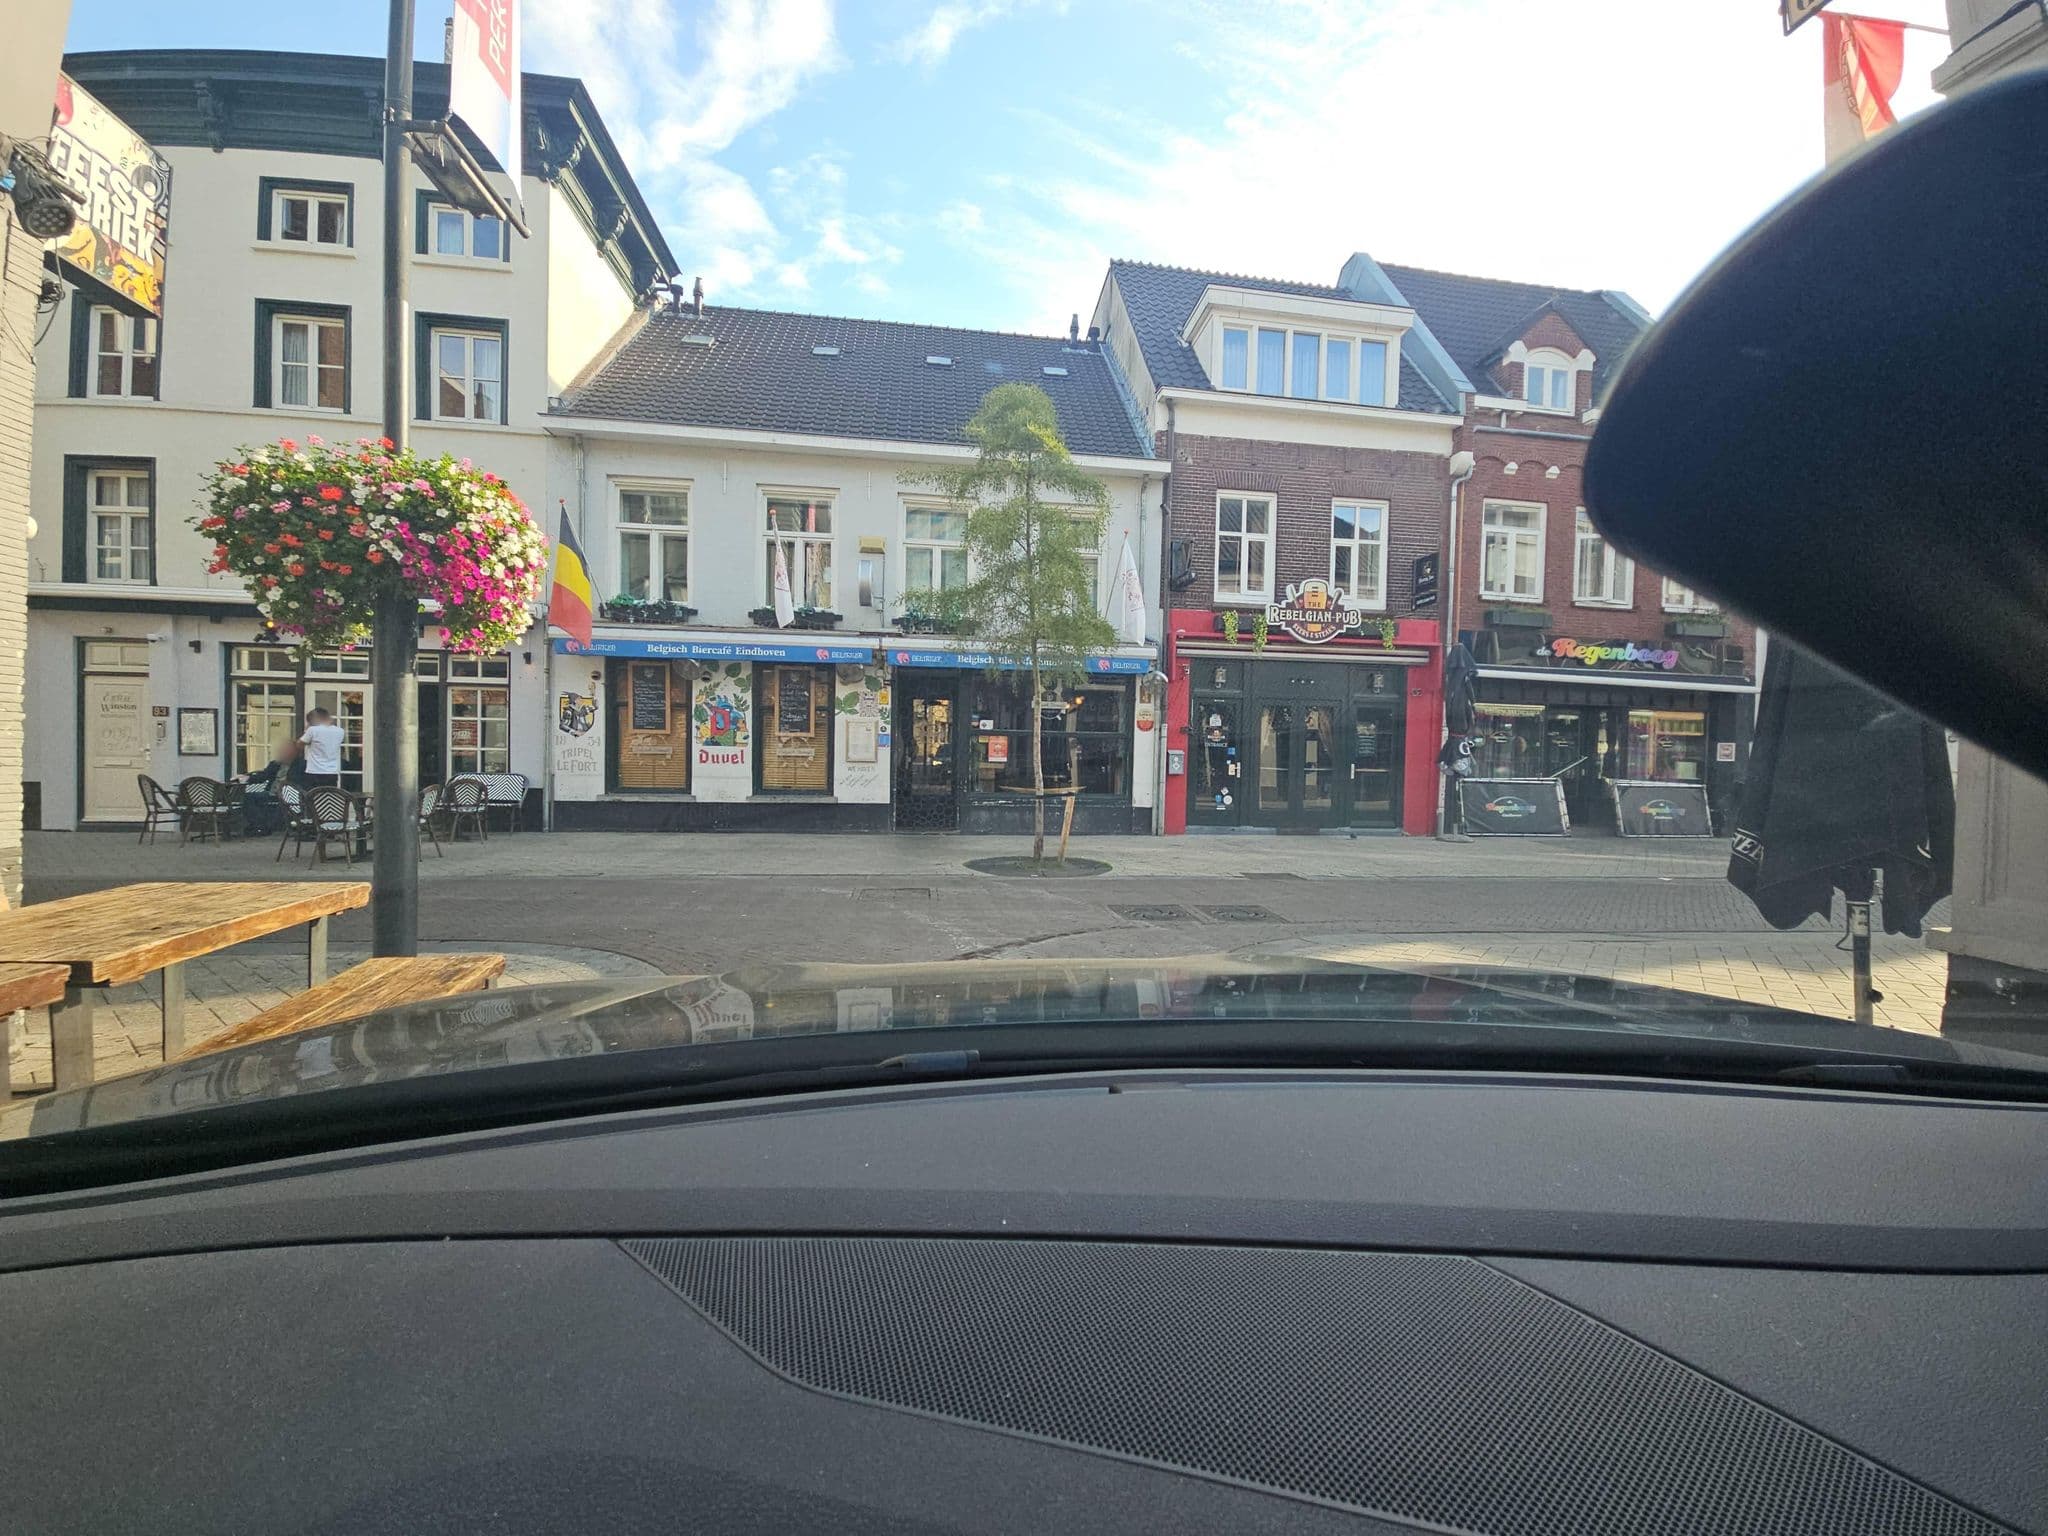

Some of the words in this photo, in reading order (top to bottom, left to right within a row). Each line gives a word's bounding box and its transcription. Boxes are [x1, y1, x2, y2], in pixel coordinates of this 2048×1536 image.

[50, 126, 155, 228] FEEST
[647, 644, 688, 655] Belgisch
[692, 645, 732, 655] Biercafé
[735, 647, 786, 657] Eindhoven
[1536, 647, 1551, 656] de
[1552, 638, 1680, 669] Regenboog
[957, 655, 994, 665] Belgisch
[153, 708, 168, 716] 93
[561, 747, 593, 760] TRIPEL
[699, 749, 745, 764] Duvel
